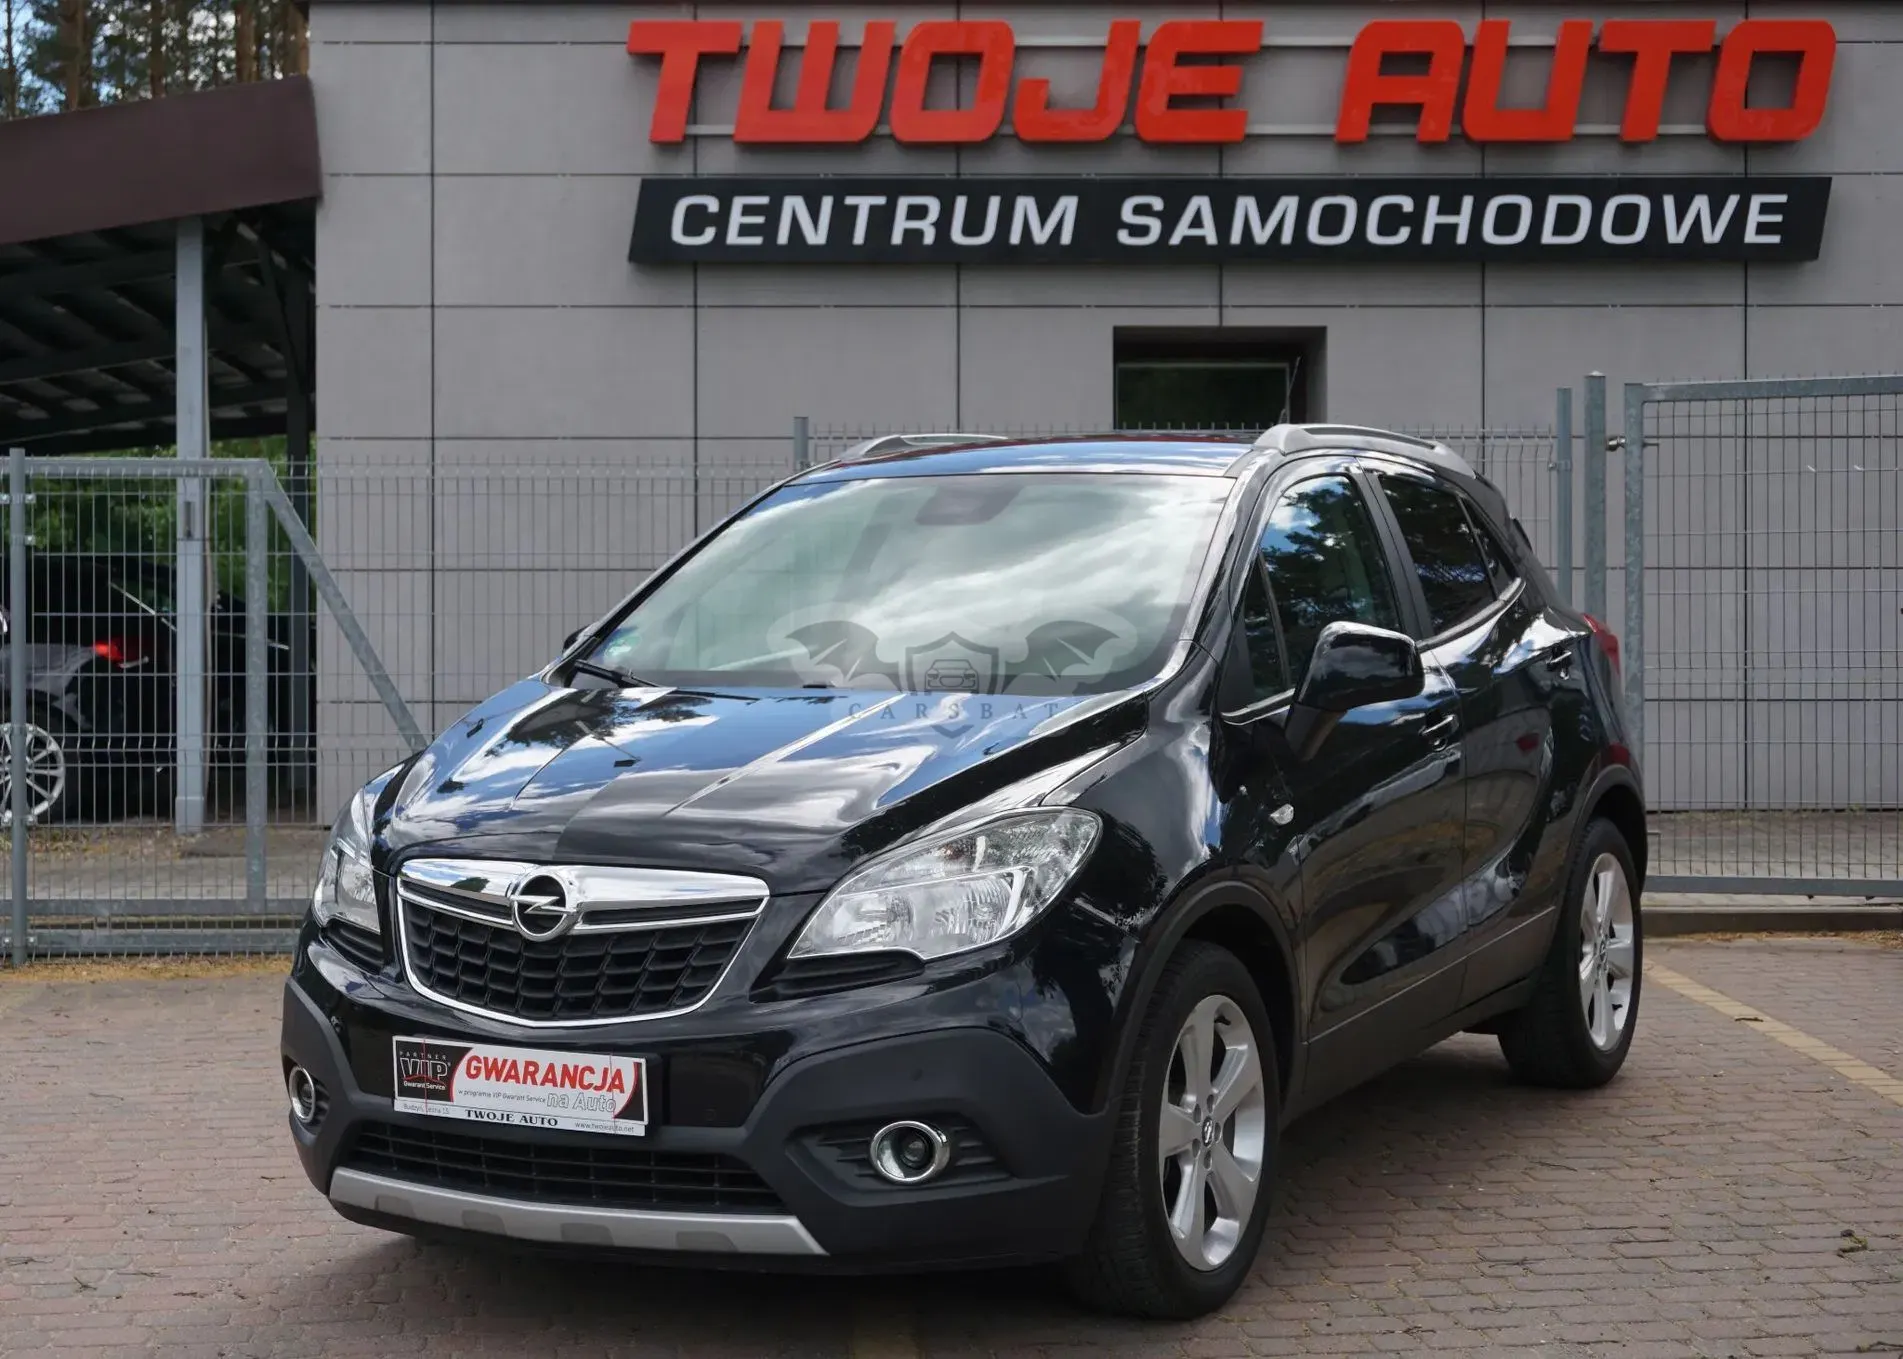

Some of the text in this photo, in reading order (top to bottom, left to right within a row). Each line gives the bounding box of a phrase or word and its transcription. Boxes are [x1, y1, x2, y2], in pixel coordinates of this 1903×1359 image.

[627, 20, 1837, 142] TWOJE AUTO
[670, 194, 1789, 246] CENTRUM SAMOCHODOWE
[400, 1057, 448, 1081] VIP
[465, 1055, 625, 1093] GWARANCJA
[425, 1082, 446, 1091] Service
[546, 1092, 617, 1113] na Auto
[465, 1109, 558, 1127] TWOJE AUTO
